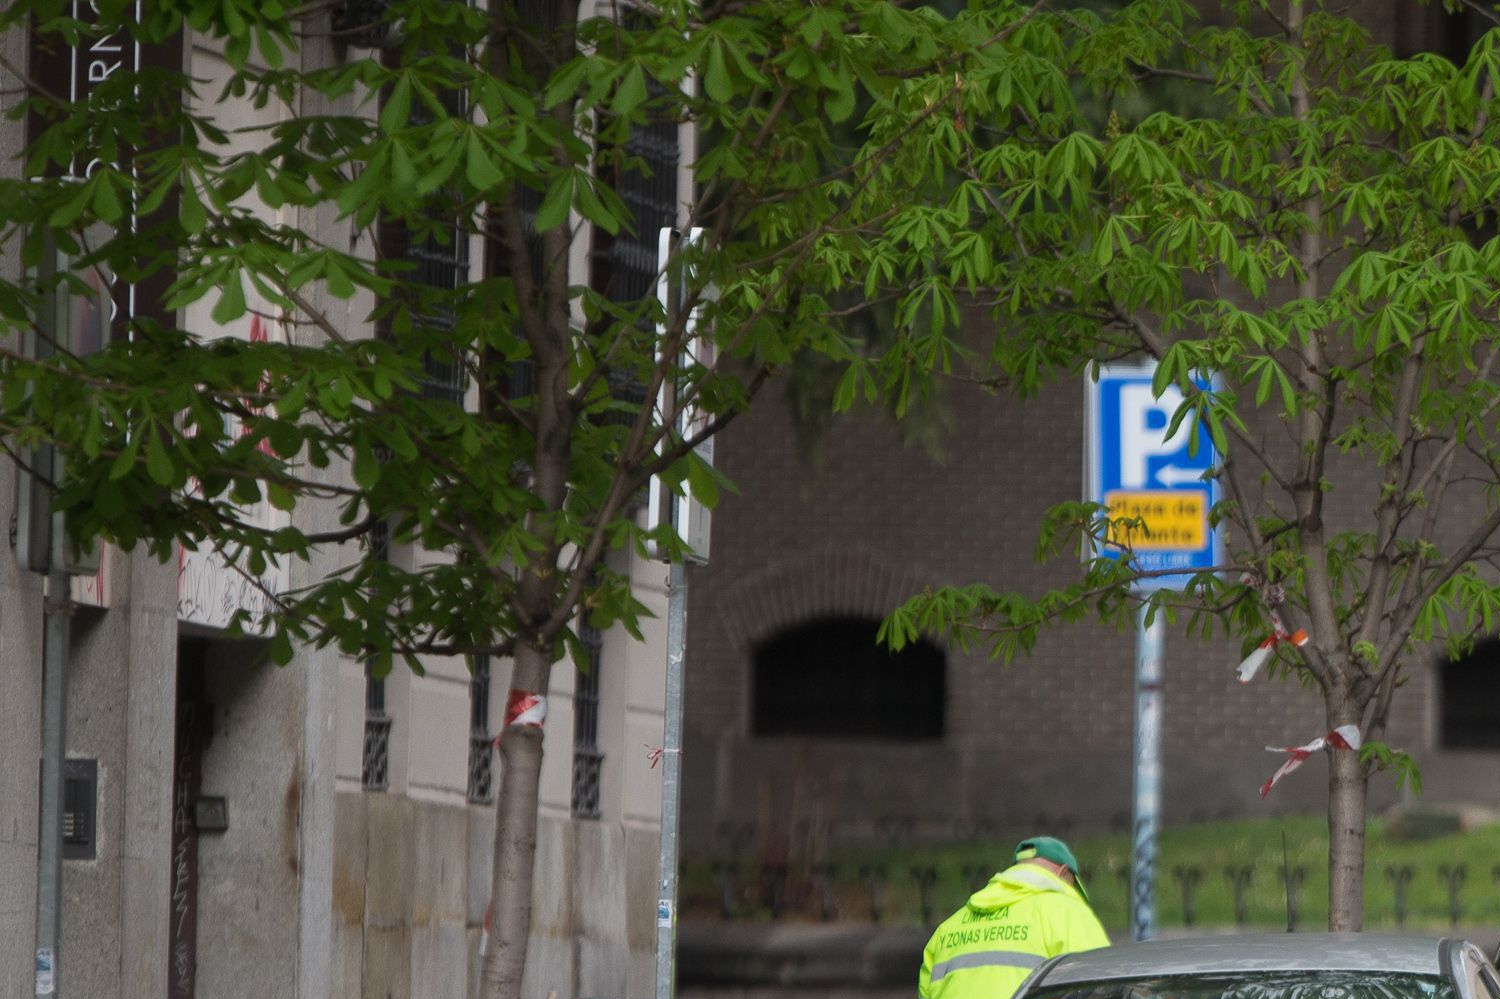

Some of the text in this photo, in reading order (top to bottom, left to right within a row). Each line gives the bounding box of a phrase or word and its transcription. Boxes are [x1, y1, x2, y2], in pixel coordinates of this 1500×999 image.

[1119, 383, 1192, 490] P
[940, 925, 1029, 951] Y ZONAS VERDES
